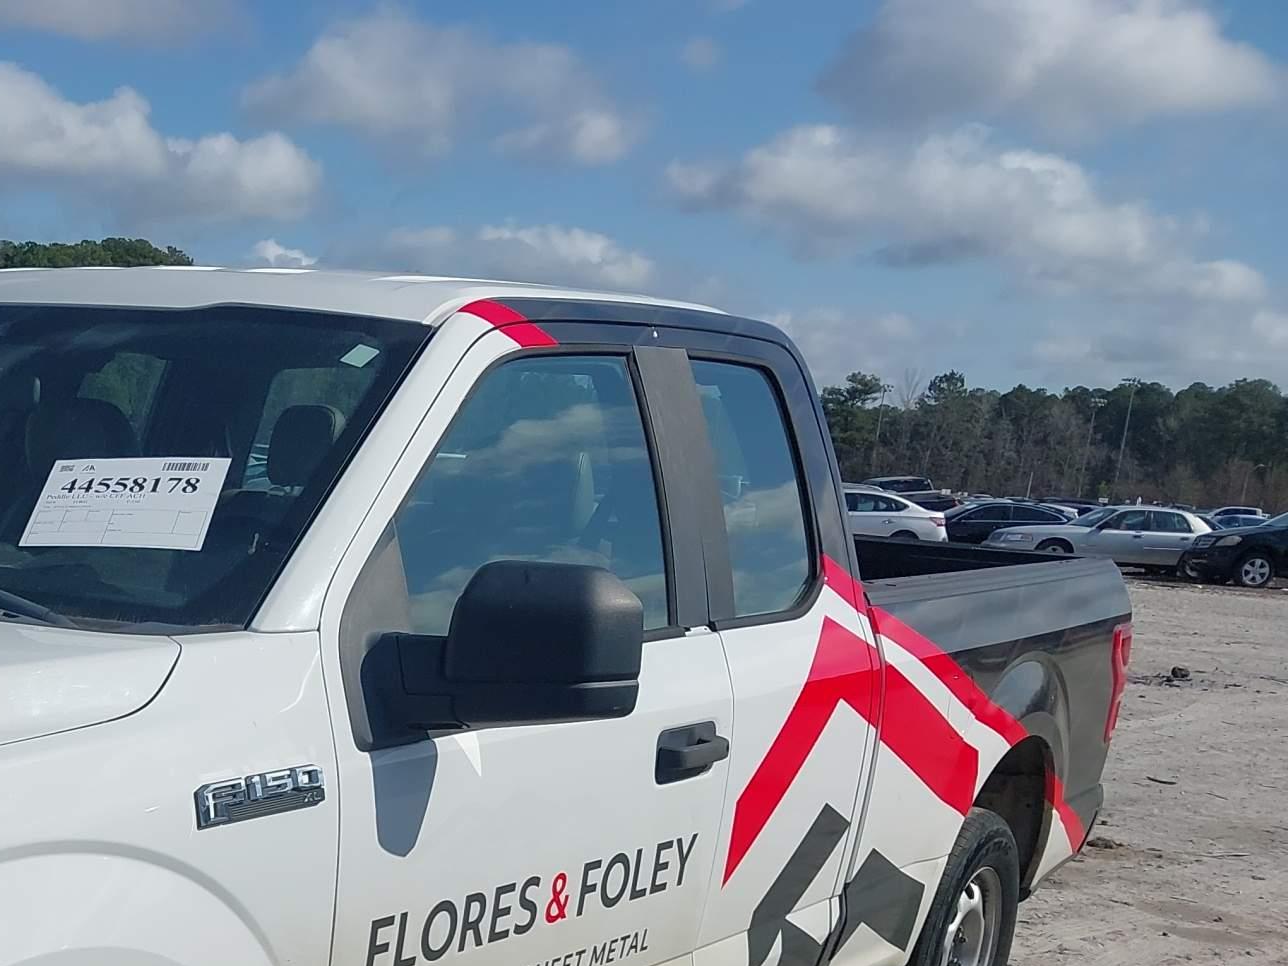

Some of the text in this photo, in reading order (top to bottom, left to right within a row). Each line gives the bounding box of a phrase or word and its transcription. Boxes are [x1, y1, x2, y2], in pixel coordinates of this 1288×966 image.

[60, 477, 200, 494] 44558178
[545, 872, 569, 924] &
[576, 833, 698, 917] FOLEY
